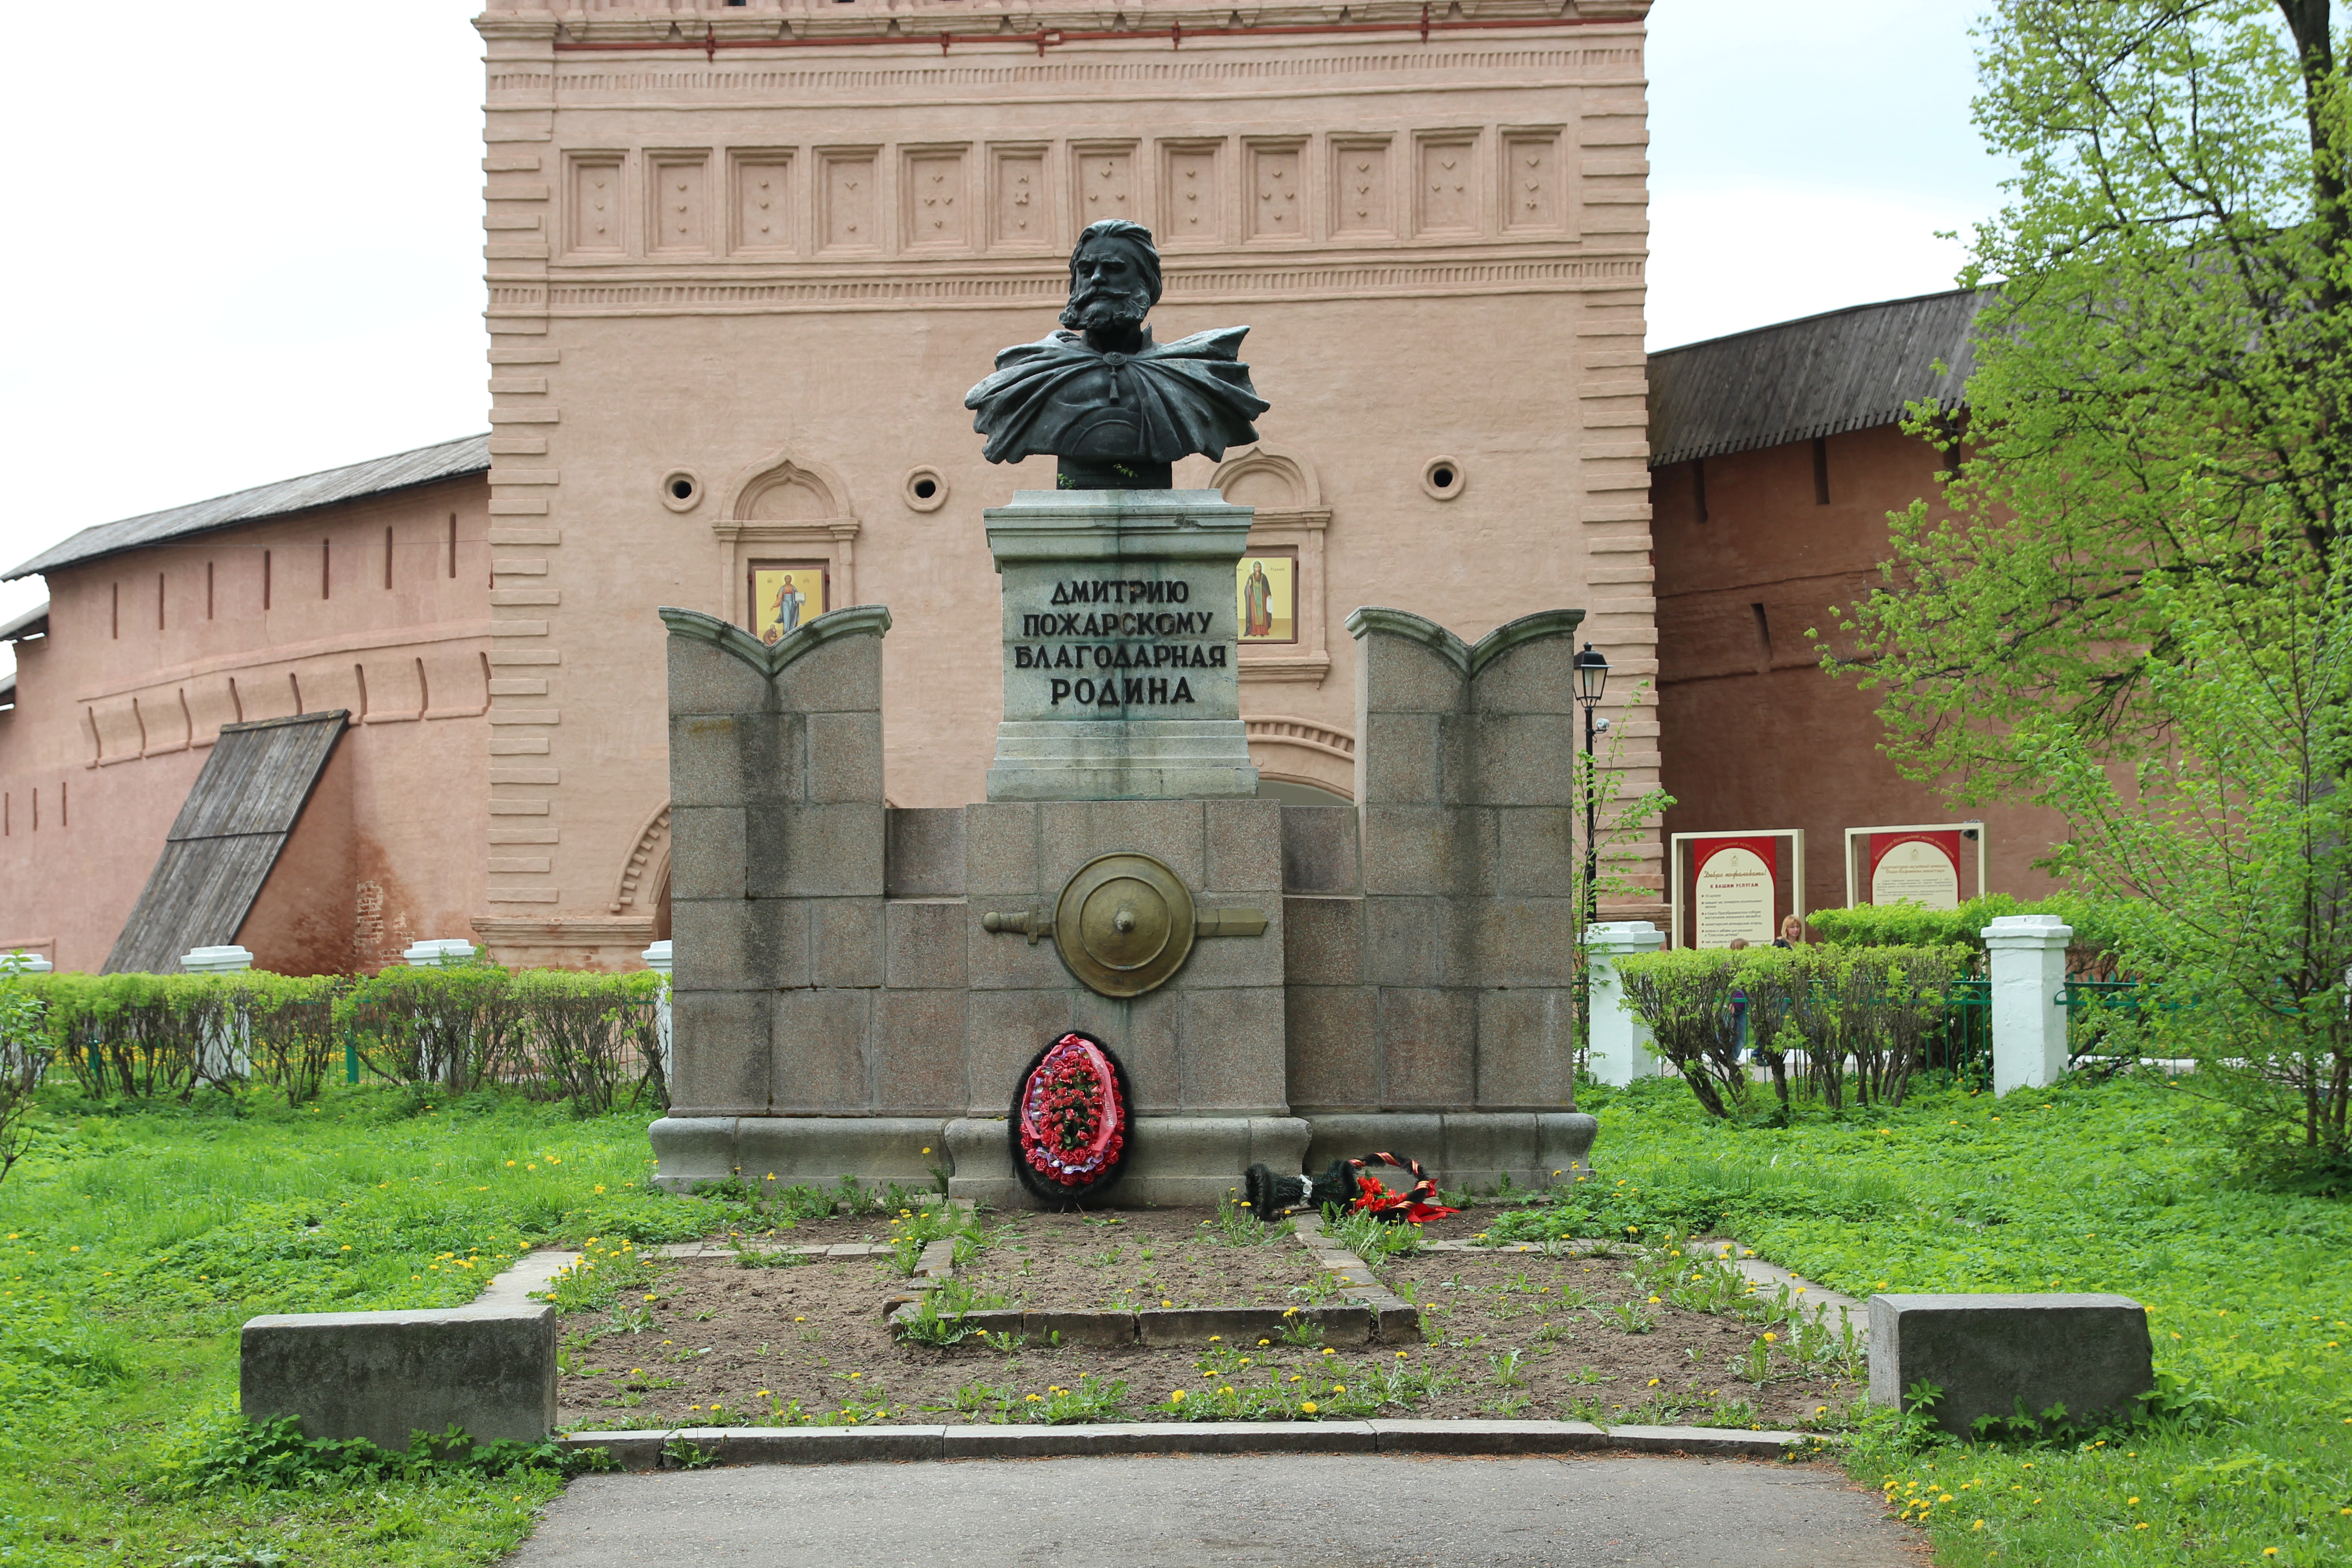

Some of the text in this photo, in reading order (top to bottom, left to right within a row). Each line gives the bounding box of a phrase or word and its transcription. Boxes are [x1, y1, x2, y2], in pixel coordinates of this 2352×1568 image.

[1051, 580, 1189, 605] ДМИТРИЮ
[1023, 612, 1213, 636] ПОЖАРСКОМУ
[1015, 644, 1226, 668] БЛАГОДАРНАЯ
[1051, 676, 1195, 706] РОДИНА
[1703, 869, 1767, 880] Добро пожаловать!
